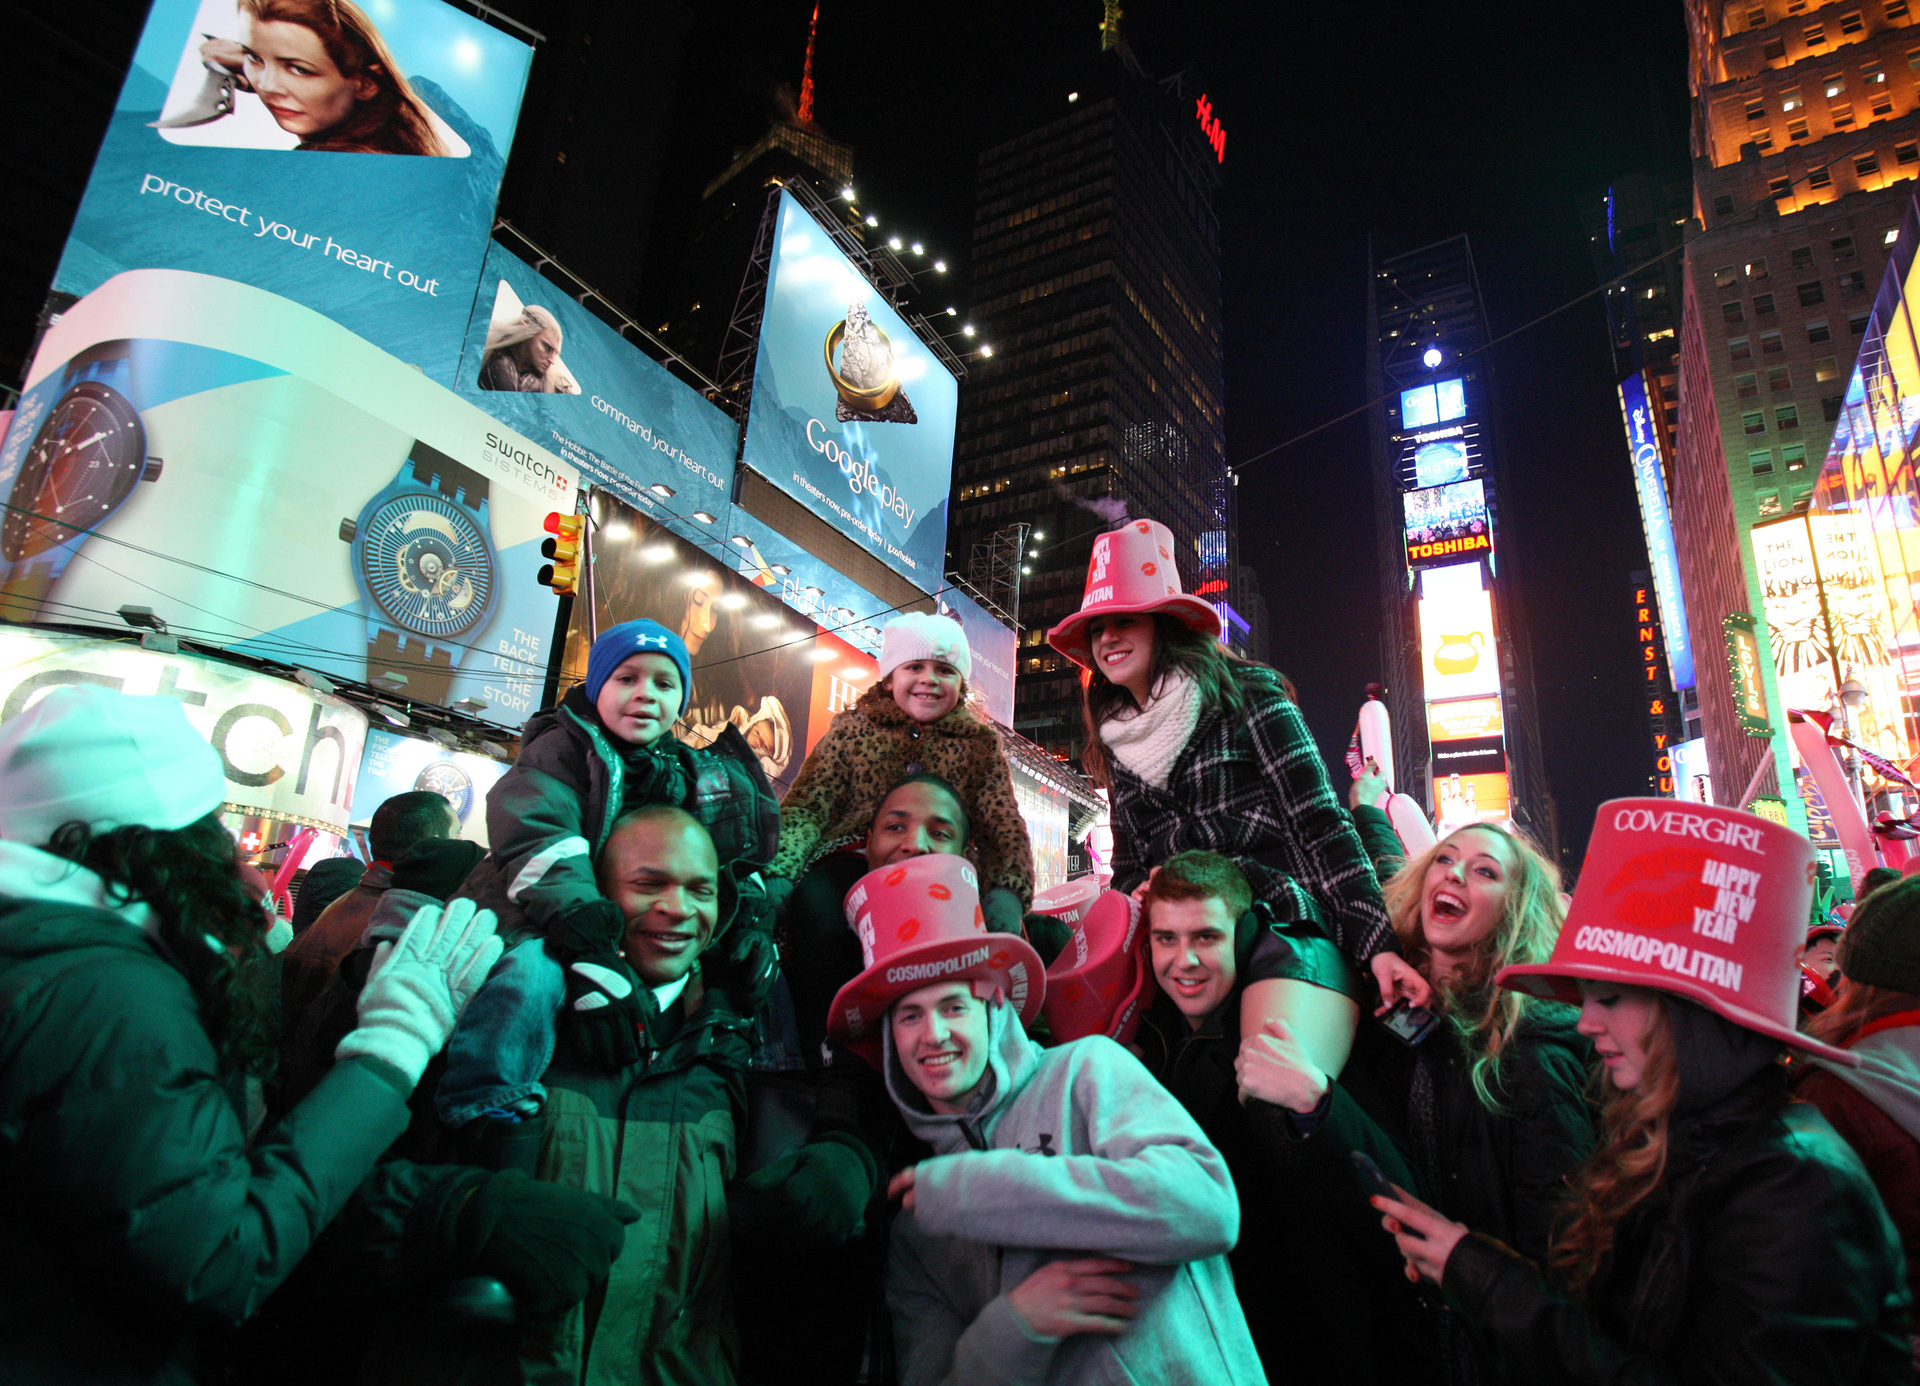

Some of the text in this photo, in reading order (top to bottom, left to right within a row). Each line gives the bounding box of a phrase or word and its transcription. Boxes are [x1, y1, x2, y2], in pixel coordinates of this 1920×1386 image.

[140, 173, 439, 297] protect your heart out
[591, 395, 725, 491] command your heart out
[1414, 426, 1463, 443] TOSHIBA
[485, 432, 555, 484] swatch
[552, 430, 564, 443] The
[565, 439, 588, 457] Hobbit:
[588, 452, 600, 466] The
[600, 460, 617, 476] Battle
[618, 471, 625, 479] of
[806, 418, 915, 529] Google play
[482, 450, 565, 504] SISTEM51
[560, 447, 568, 456] in
[567, 451, 594, 472] theaters
[637, 493, 655, 508] today
[1636, 443, 1665, 531] CINDERELLA
[793, 471, 800, 484] in
[800, 477, 825, 502] theaters
[841, 508, 867, 532] pre-order
[867, 527, 883, 546] today
[1408, 535, 1489, 559] TOSHIBA
[1763, 555, 1803, 575] LION
[1766, 539, 1794, 553] THE
[1656, 538, 1667, 552] IN
[1668, 601, 1683, 638] MARCH
[498, 639, 537, 665] BACK
[513, 628, 540, 650] THE
[1636, 589, 1657, 681] ERNST
[1650, 700, 1664, 714] &
[492, 654, 534, 681] TELLS
[505, 676, 532, 697] THE
[482, 685, 530, 713] STORY
[374, 735, 390, 745] THE
[369, 758, 385, 769] THE
[1614, 809, 1766, 856] COVERGIRL
[1701, 858, 1761, 898] HAPPY
[1713, 887, 1757, 923] NEW
[1692, 906, 1738, 944] YEAR
[887, 945, 989, 983] COSMOPOLITAN
[1574, 925, 1743, 992] COSMOPOLITAN
